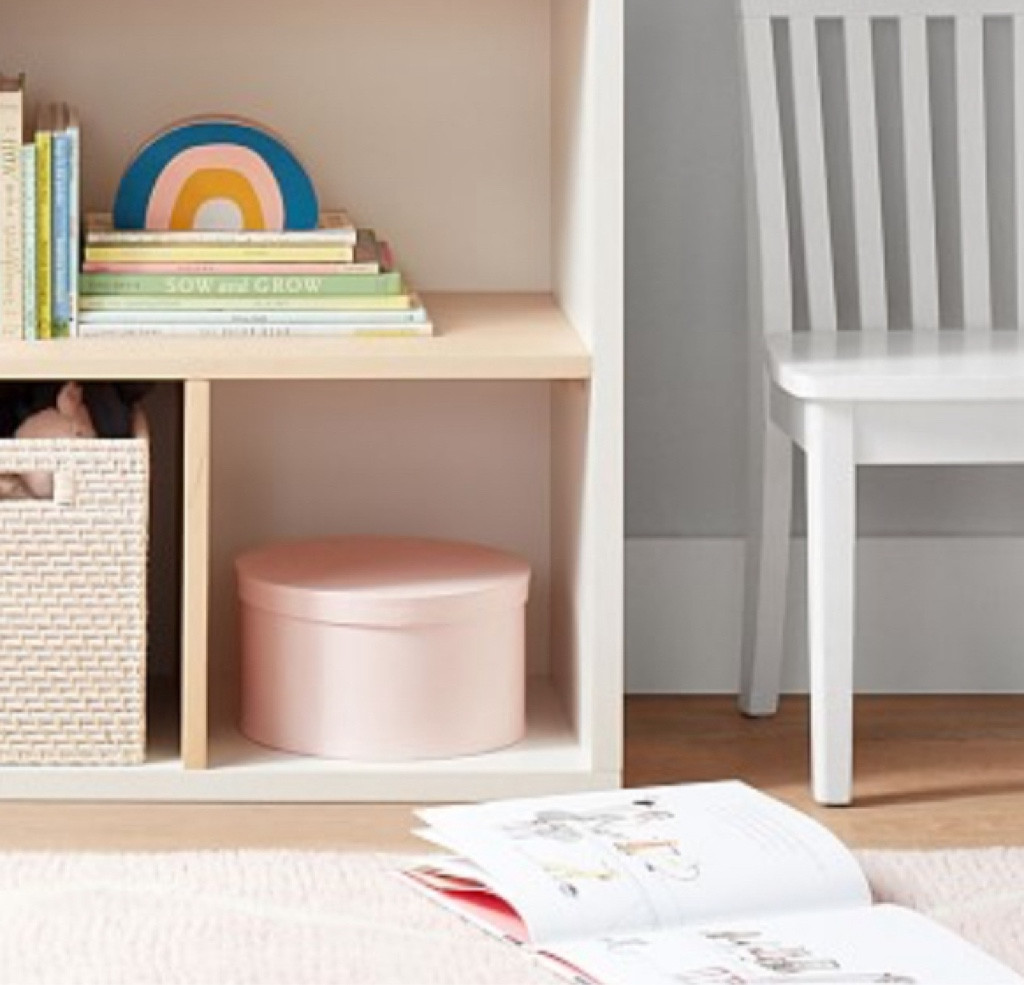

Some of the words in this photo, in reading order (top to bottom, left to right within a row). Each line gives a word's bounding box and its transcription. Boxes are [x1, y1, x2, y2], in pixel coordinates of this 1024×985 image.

[165, 277, 211, 293] SOW
[217, 277, 249, 293] and
[253, 276, 323, 293] GROW
